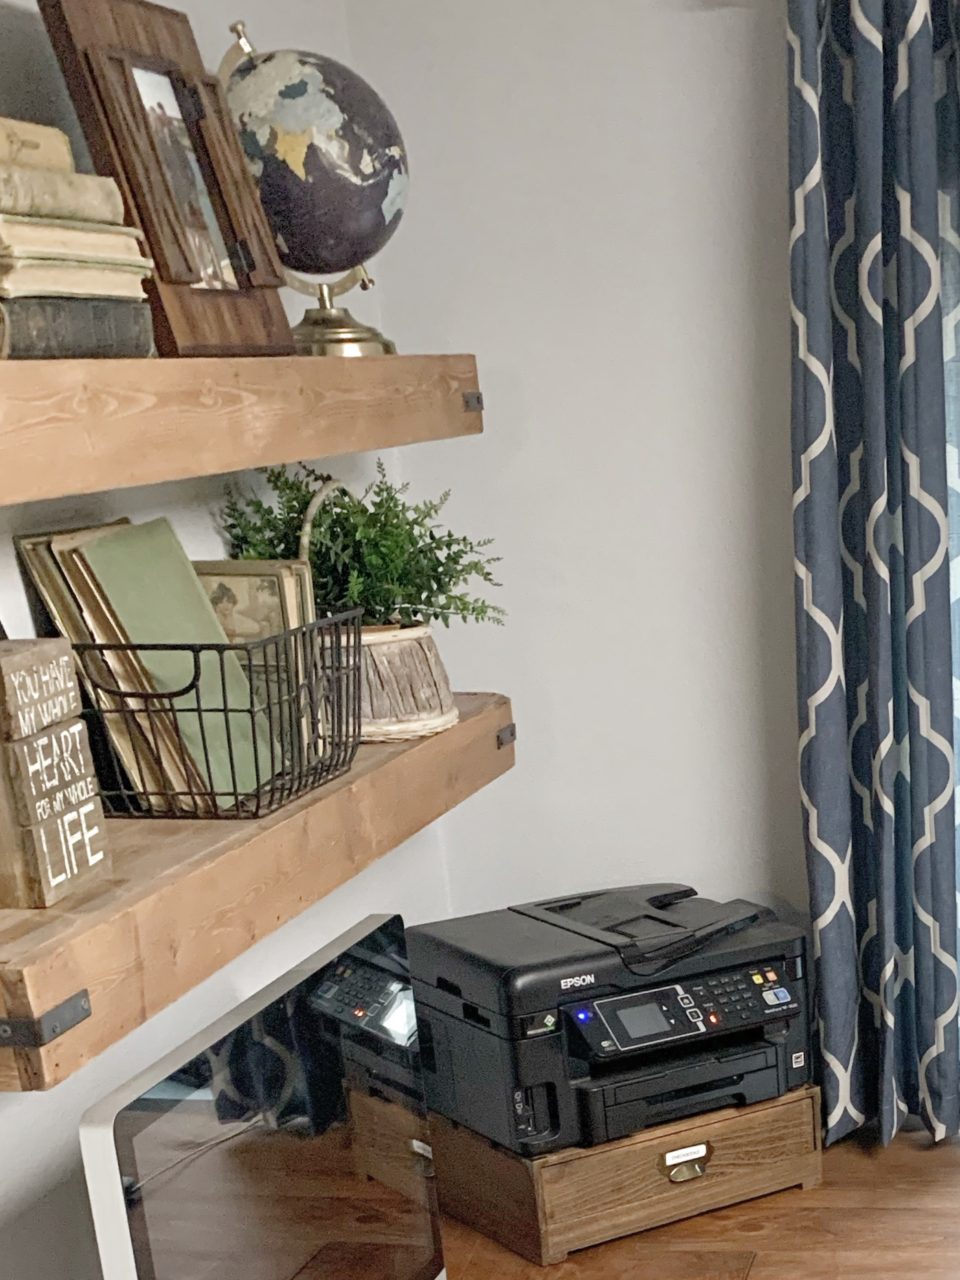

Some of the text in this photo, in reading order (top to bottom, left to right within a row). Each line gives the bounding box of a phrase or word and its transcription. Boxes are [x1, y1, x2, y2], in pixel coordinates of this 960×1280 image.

[11, 656, 74, 705] YOU HAVE
[18, 706, 38, 738] MY
[23, 722, 84, 795] HEART
[35, 776, 95, 821] FOR MY WHOLE
[40, 803, 104, 888] LIFE
[560, 974, 595, 989] EPSON
